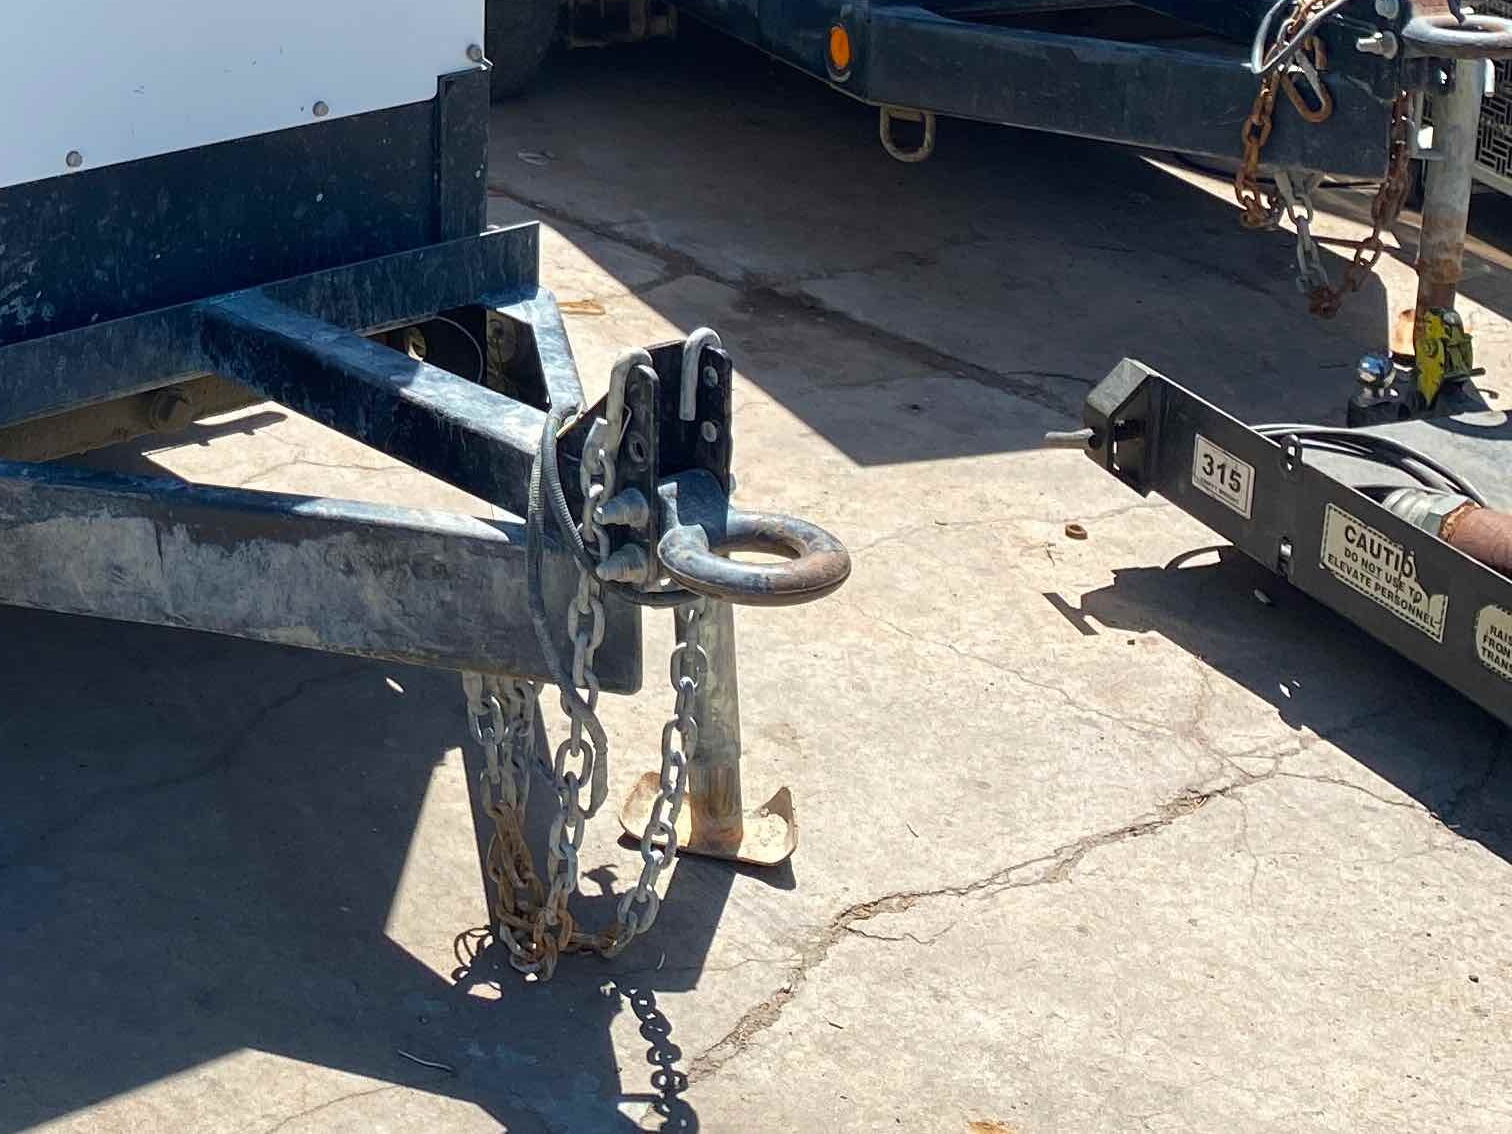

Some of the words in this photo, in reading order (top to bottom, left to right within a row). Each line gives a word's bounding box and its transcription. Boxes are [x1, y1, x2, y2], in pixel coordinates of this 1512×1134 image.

[1201, 453, 1243, 494] 315
[1344, 525, 1414, 579] CAUTIO
[1344, 547, 1359, 563] DO
[1361, 558, 1383, 578] NOT
[1385, 572, 1406, 592] USE
[1327, 553, 1372, 588] ELEVATE
[1374, 582, 1438, 629] PERSONNEL
